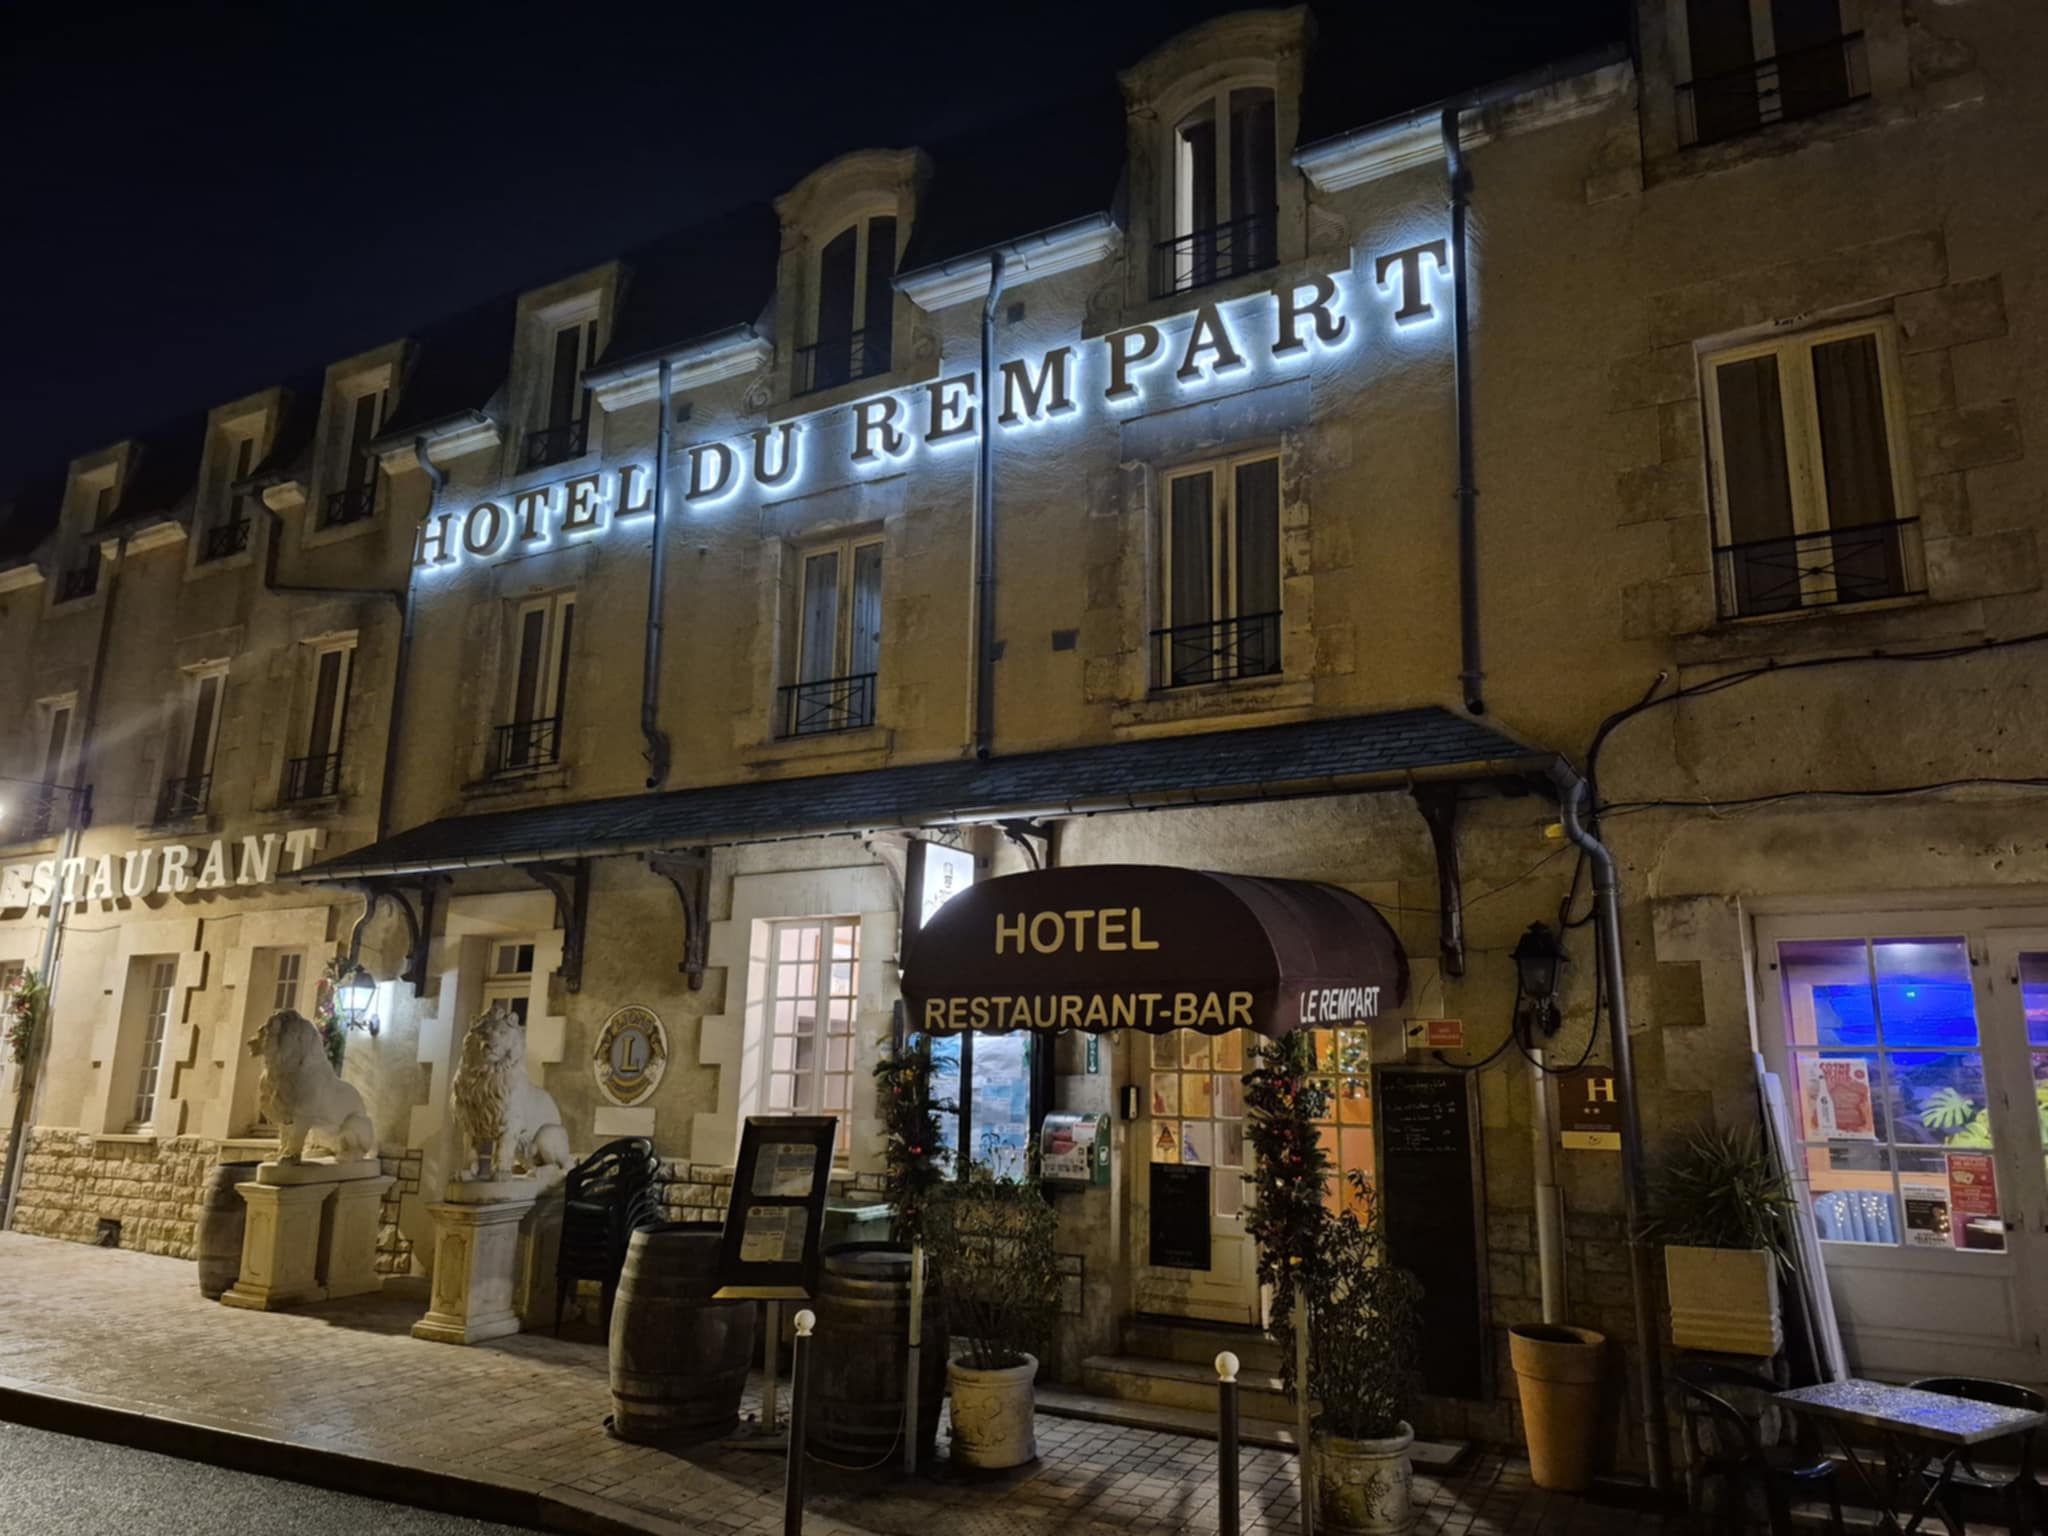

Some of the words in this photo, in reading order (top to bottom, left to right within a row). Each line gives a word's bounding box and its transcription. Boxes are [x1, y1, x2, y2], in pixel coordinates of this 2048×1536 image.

[412, 463, 653, 566] HOTEL
[685, 422, 805, 503] DU
[850, 238, 1452, 464] REMPART
[995, 907, 1159, 954] HOTEL
[925, 991, 1253, 1028] RESTAURANT-BAR
[1300, 990, 1318, 1024] LE
[1319, 987, 1380, 1021] REMPART
[1587, 1078, 1616, 1103] H
